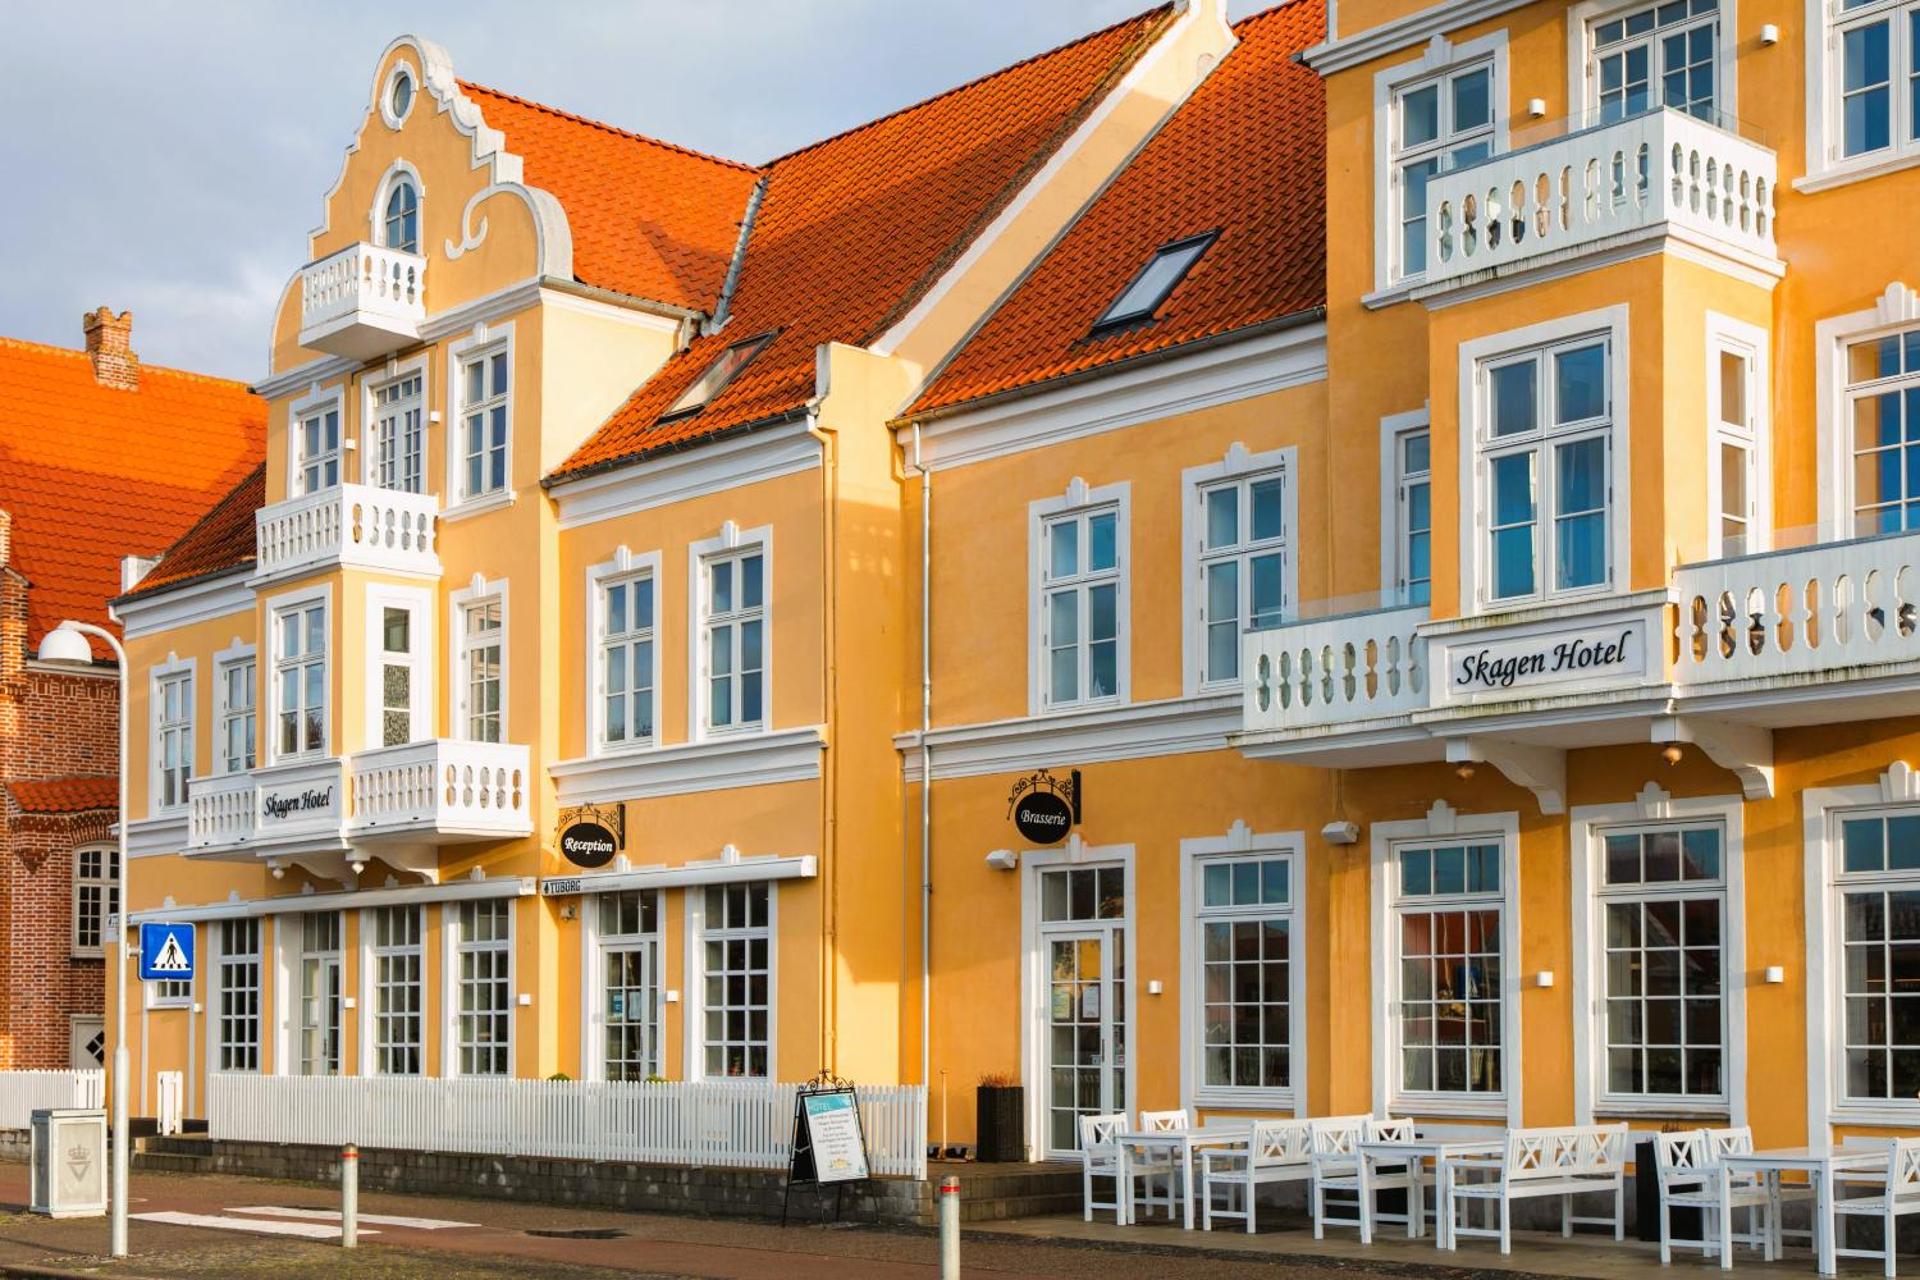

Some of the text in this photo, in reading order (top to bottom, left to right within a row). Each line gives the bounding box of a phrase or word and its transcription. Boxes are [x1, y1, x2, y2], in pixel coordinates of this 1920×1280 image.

[1456, 630, 1633, 687] Skagen Hotel
[263, 786, 333, 819] Skagen Hotel
[1020, 809, 1066, 826] Brasserie
[564, 836, 613, 855] Reception
[550, 880, 581, 894] TUBORG
